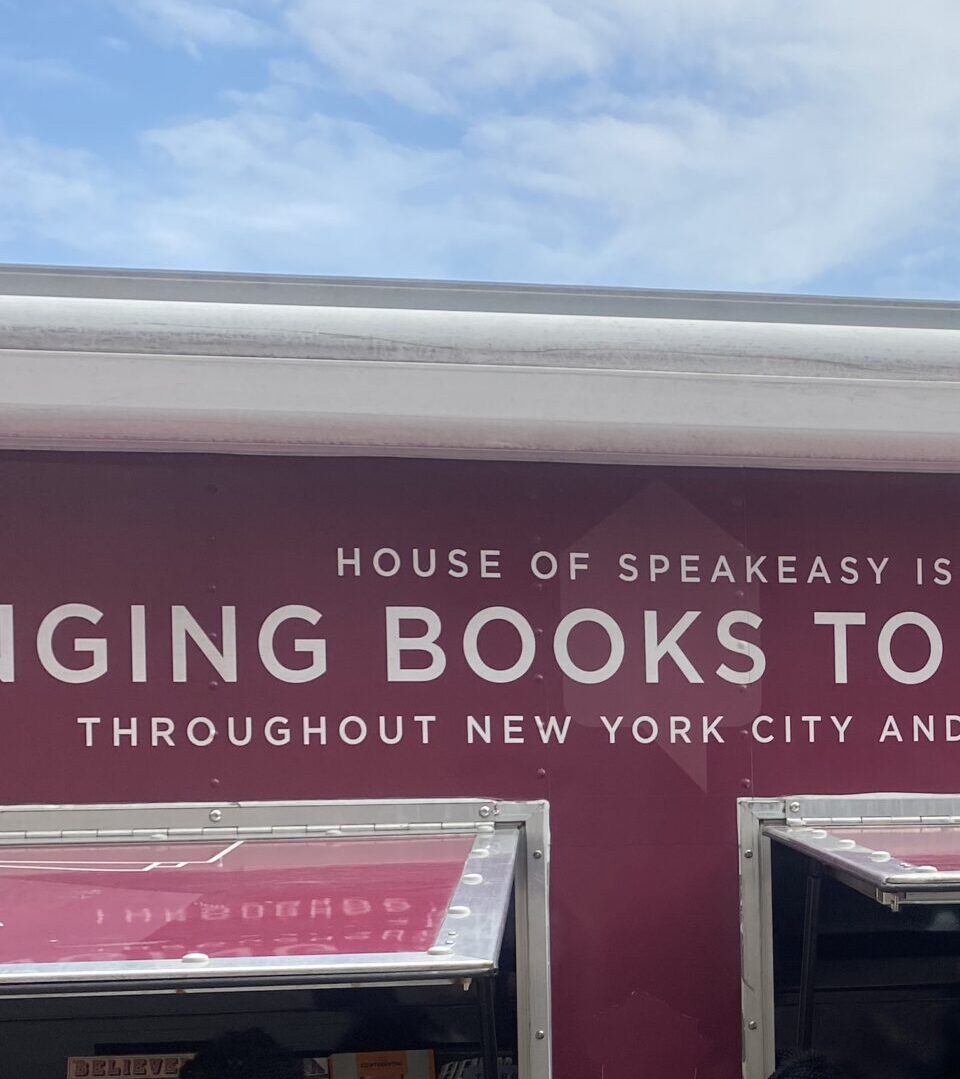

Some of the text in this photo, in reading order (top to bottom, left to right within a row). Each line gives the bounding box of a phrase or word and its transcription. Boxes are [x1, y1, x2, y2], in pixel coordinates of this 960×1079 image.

[337, 547, 952, 585] HOUSE OF SPEAKEASY IS
[0, 603, 327, 684] GING
[385, 606, 766, 685] BOOKS
[813, 611, 943, 685] TO
[77, 715, 436, 747] THROUGHOUT
[466, 715, 572, 744] NEW
[599, 714, 725, 744] YORK
[751, 714, 853, 744] CITY
[72, 1058, 188, 1077] BELIEVE
